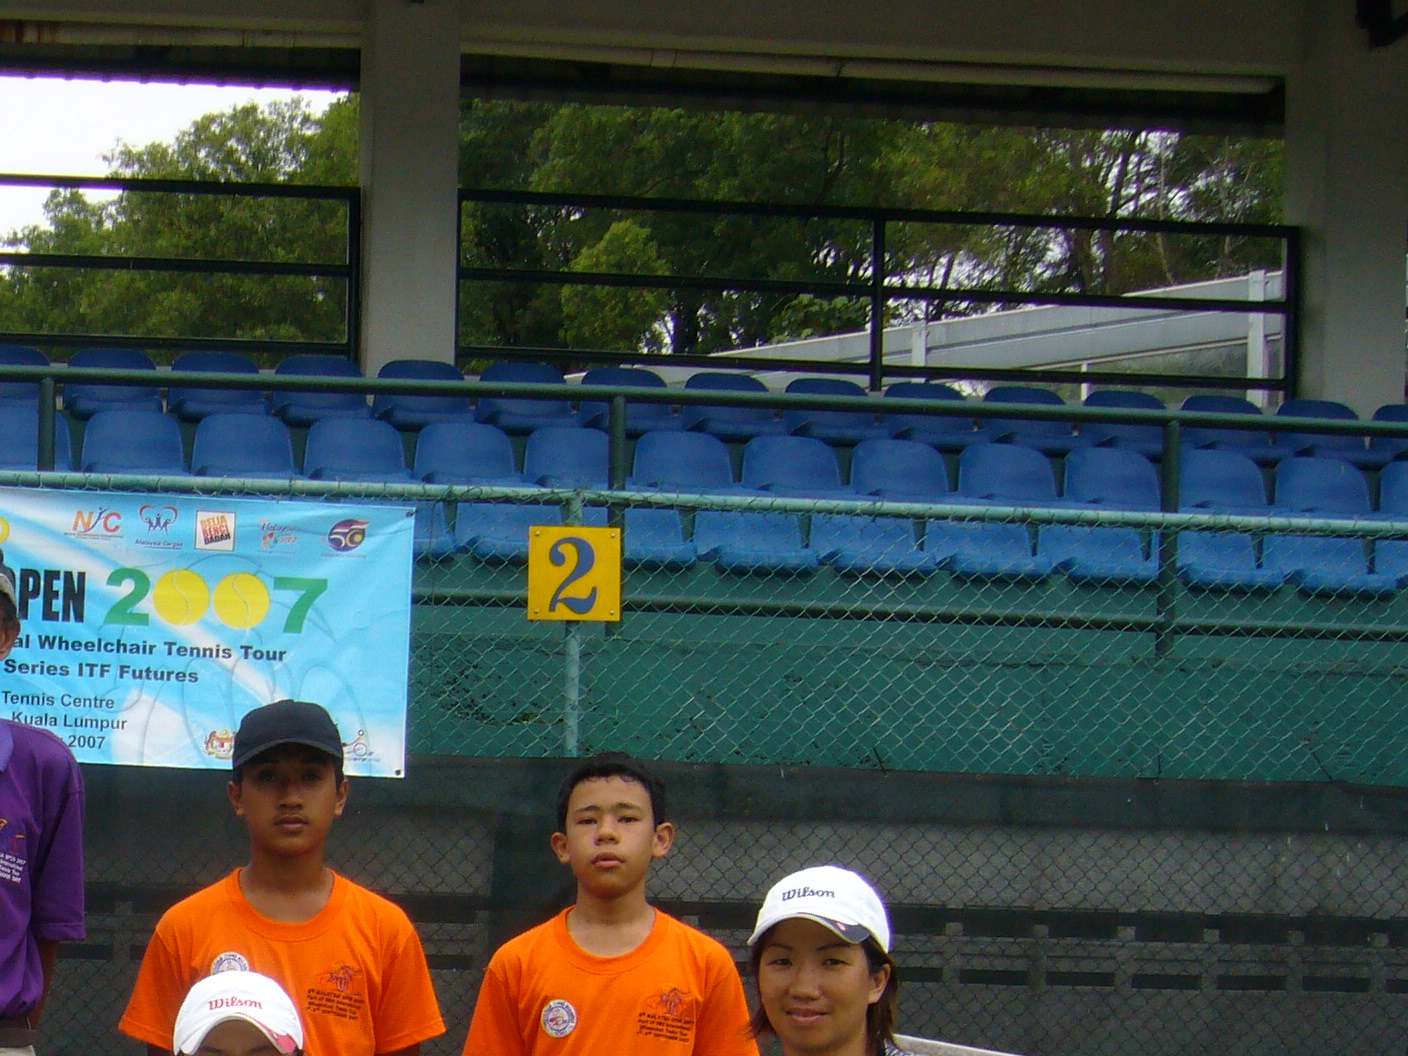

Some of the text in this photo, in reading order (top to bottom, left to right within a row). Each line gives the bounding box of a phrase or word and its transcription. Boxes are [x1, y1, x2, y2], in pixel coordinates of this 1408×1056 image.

[549, 536, 598, 615] 2
[9, 567, 86, 623] PEN
[104, 567, 328, 634] 2007
[37, 634, 156, 657] Wheelchair
[163, 640, 233, 660] Tennis
[240, 645, 287, 663] Tour
[3, 658, 70, 677] Series
[78, 662, 111, 678] ITF
[119, 664, 199, 684] Futures
[2, 690, 55, 706] Tennis
[60, 693, 115, 709] Centre
[12, 711, 128, 732] Kuala Lumpur
[67, 734, 106, 750] 2007
[782, 886, 835, 902] Wilson
[208, 996, 263, 1011] Wilson
